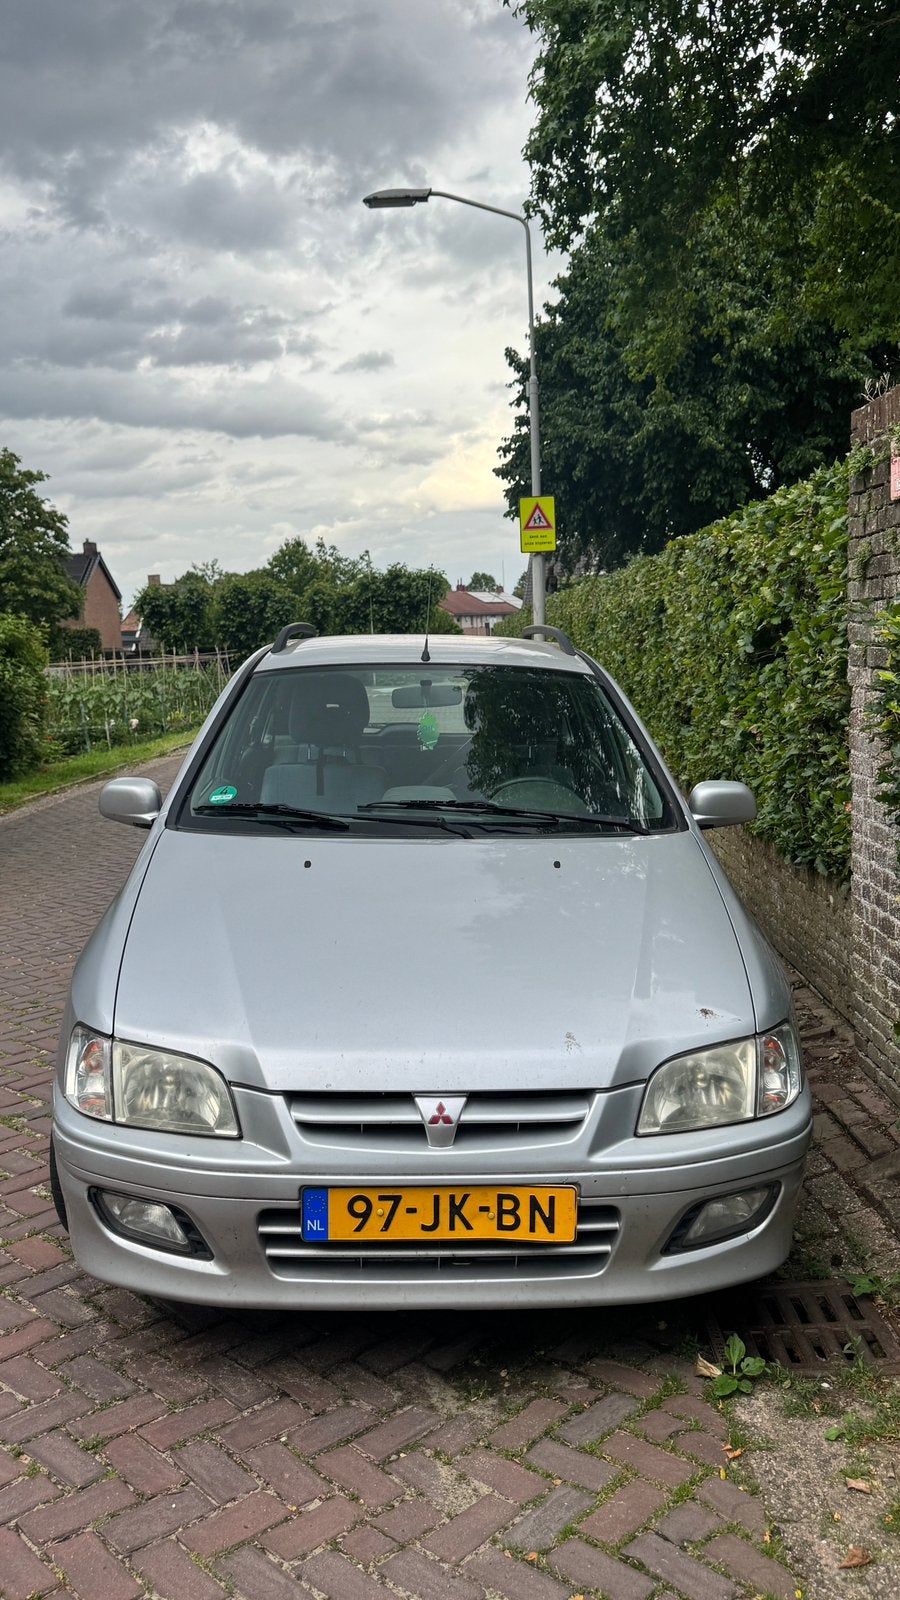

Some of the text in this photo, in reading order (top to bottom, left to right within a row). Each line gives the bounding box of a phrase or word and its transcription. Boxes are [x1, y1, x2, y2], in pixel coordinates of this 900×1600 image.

[220, 786, 228, 795] 4
[347, 1193, 555, 1234] 97-JK-BN
[307, 1219, 325, 1231] NL
